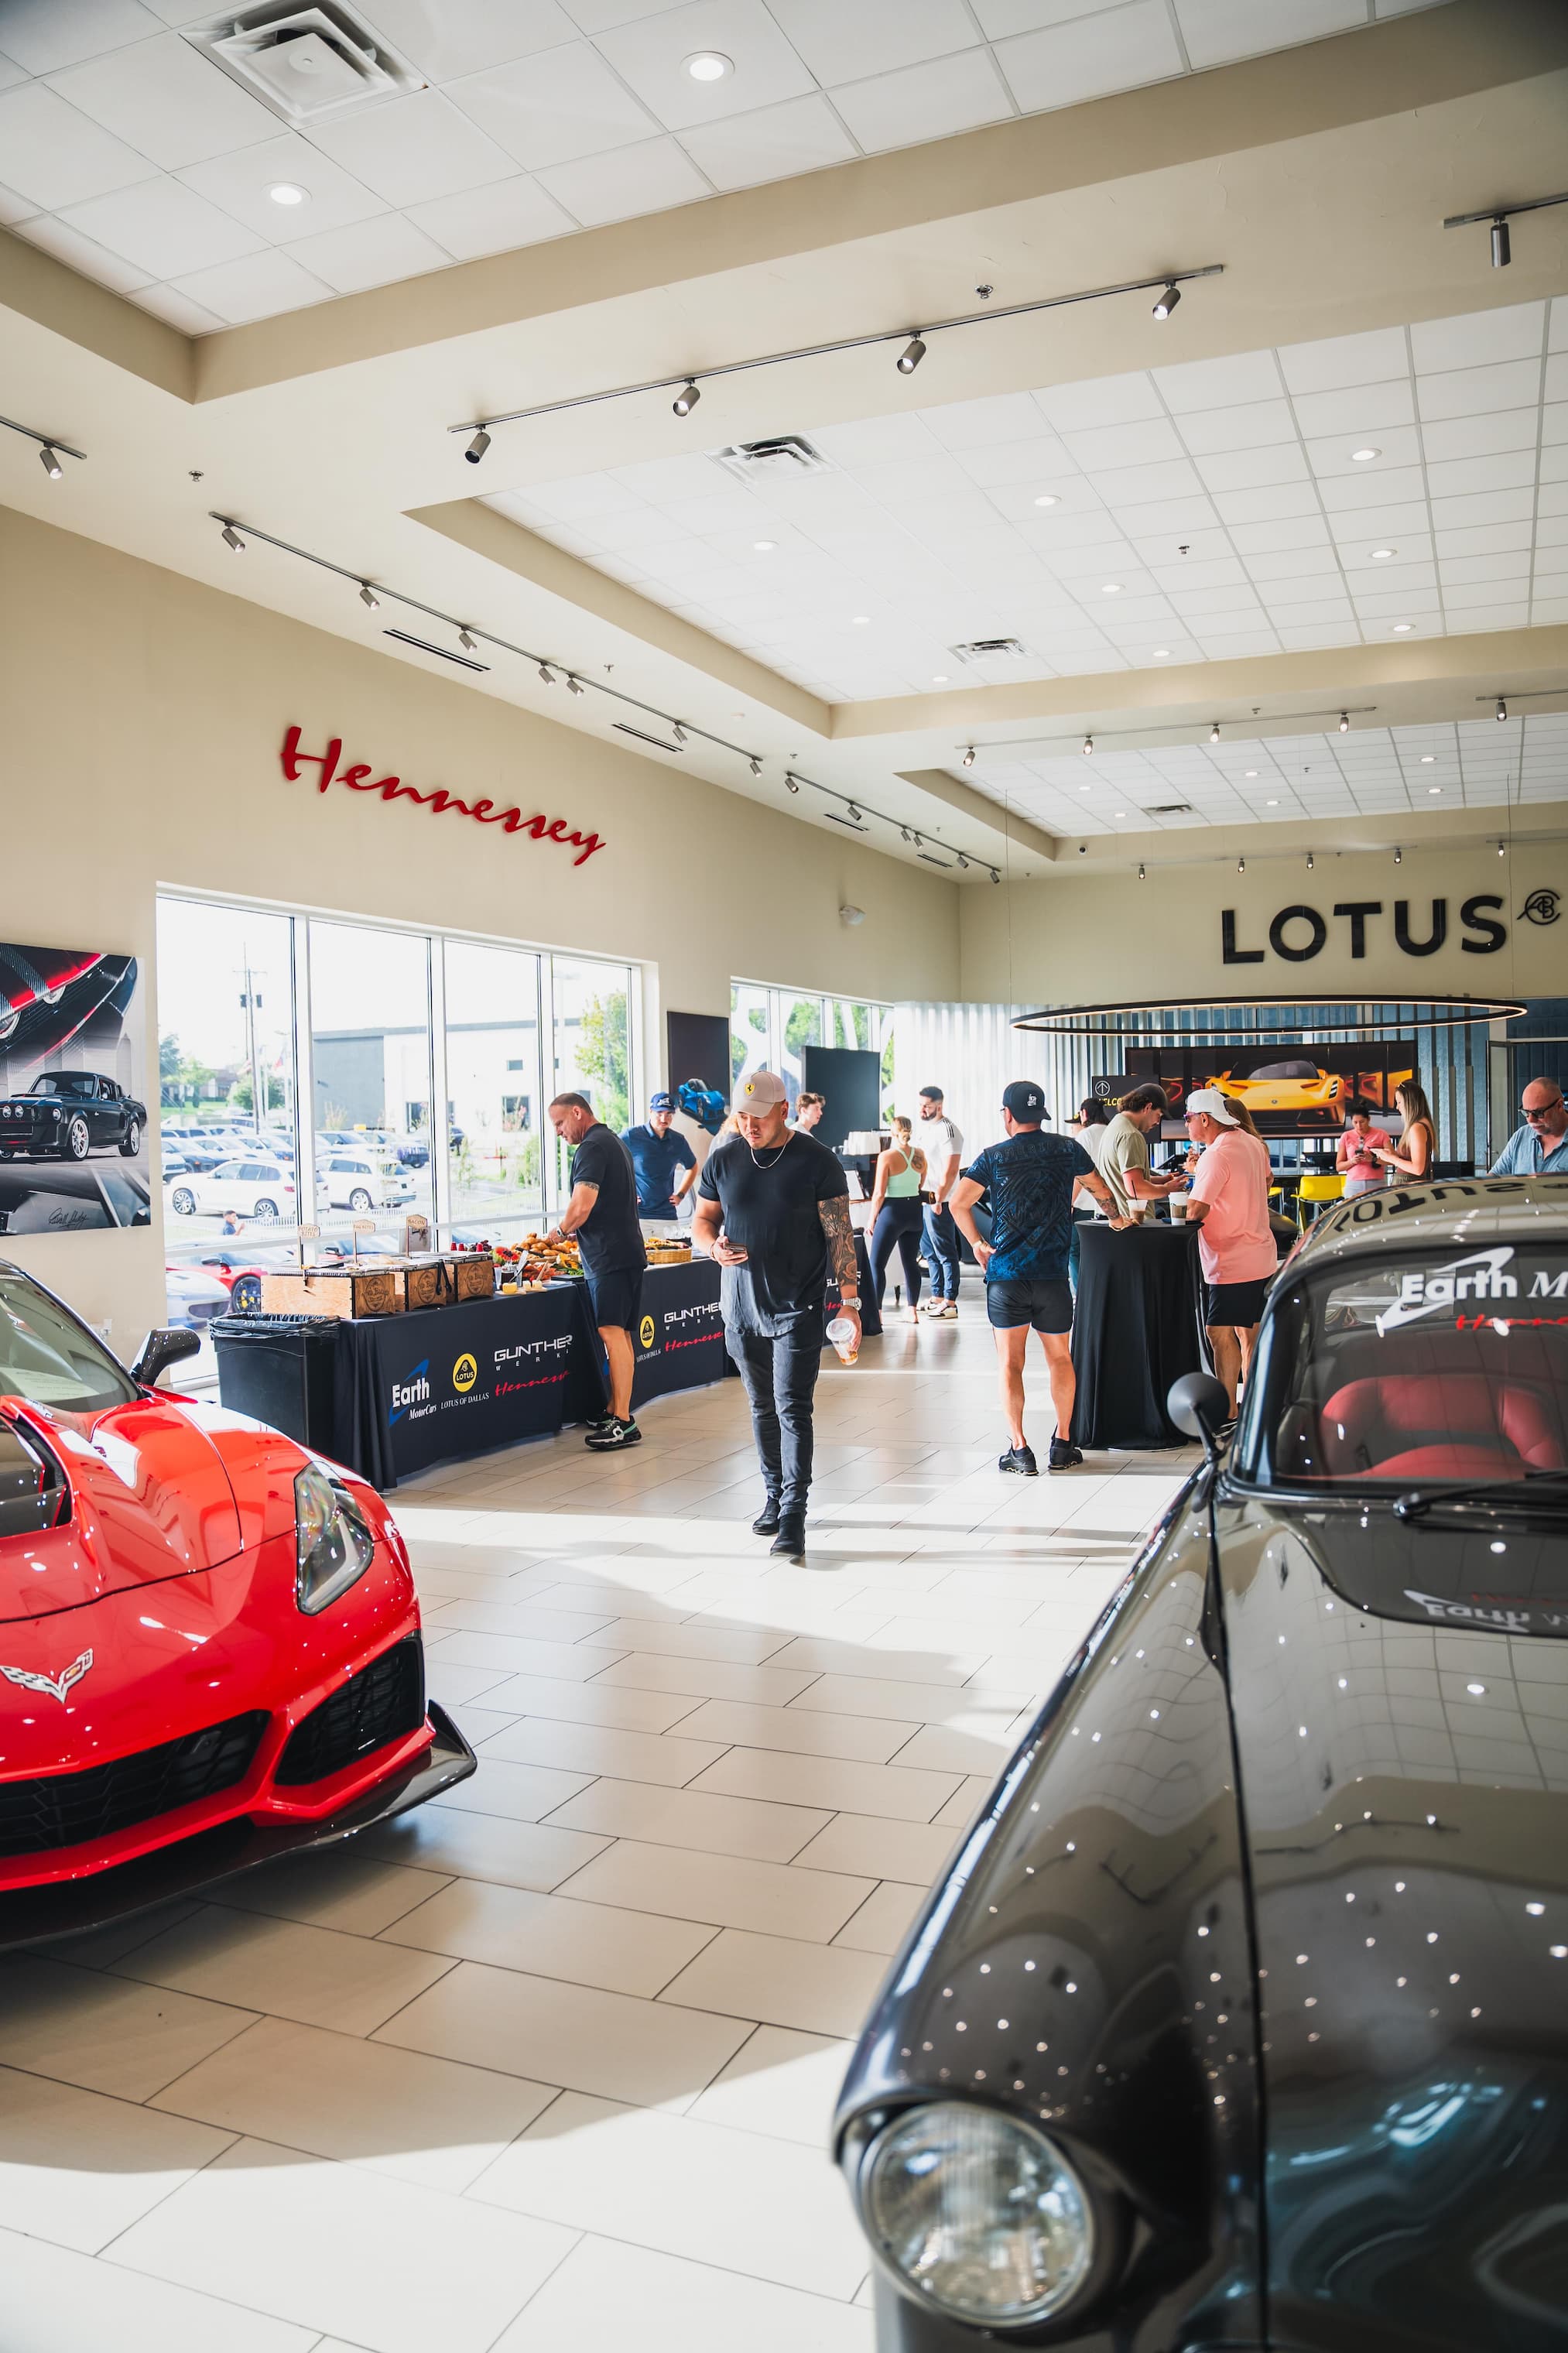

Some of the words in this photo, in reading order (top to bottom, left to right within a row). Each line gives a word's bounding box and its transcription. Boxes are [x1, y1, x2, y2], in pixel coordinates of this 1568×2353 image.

[280, 726, 606, 866] Hennessey
[1222, 896, 1507, 964] LOTUS
[1400, 1269, 1518, 1300] Earth
[663, 1301, 721, 1324] GUNTHE
[494, 1334, 573, 1362] GUNTHER
[665, 1330, 724, 1352] Hennesse
[456, 1371, 474, 1381] LOTUS
[392, 1377, 430, 1408] Earth
[440, 1399, 459, 1409] LOTUS
[459, 1396, 468, 1406] OF
[467, 1392, 490, 1404] DALLAS
[409, 1403, 438, 1420] MotorCars
